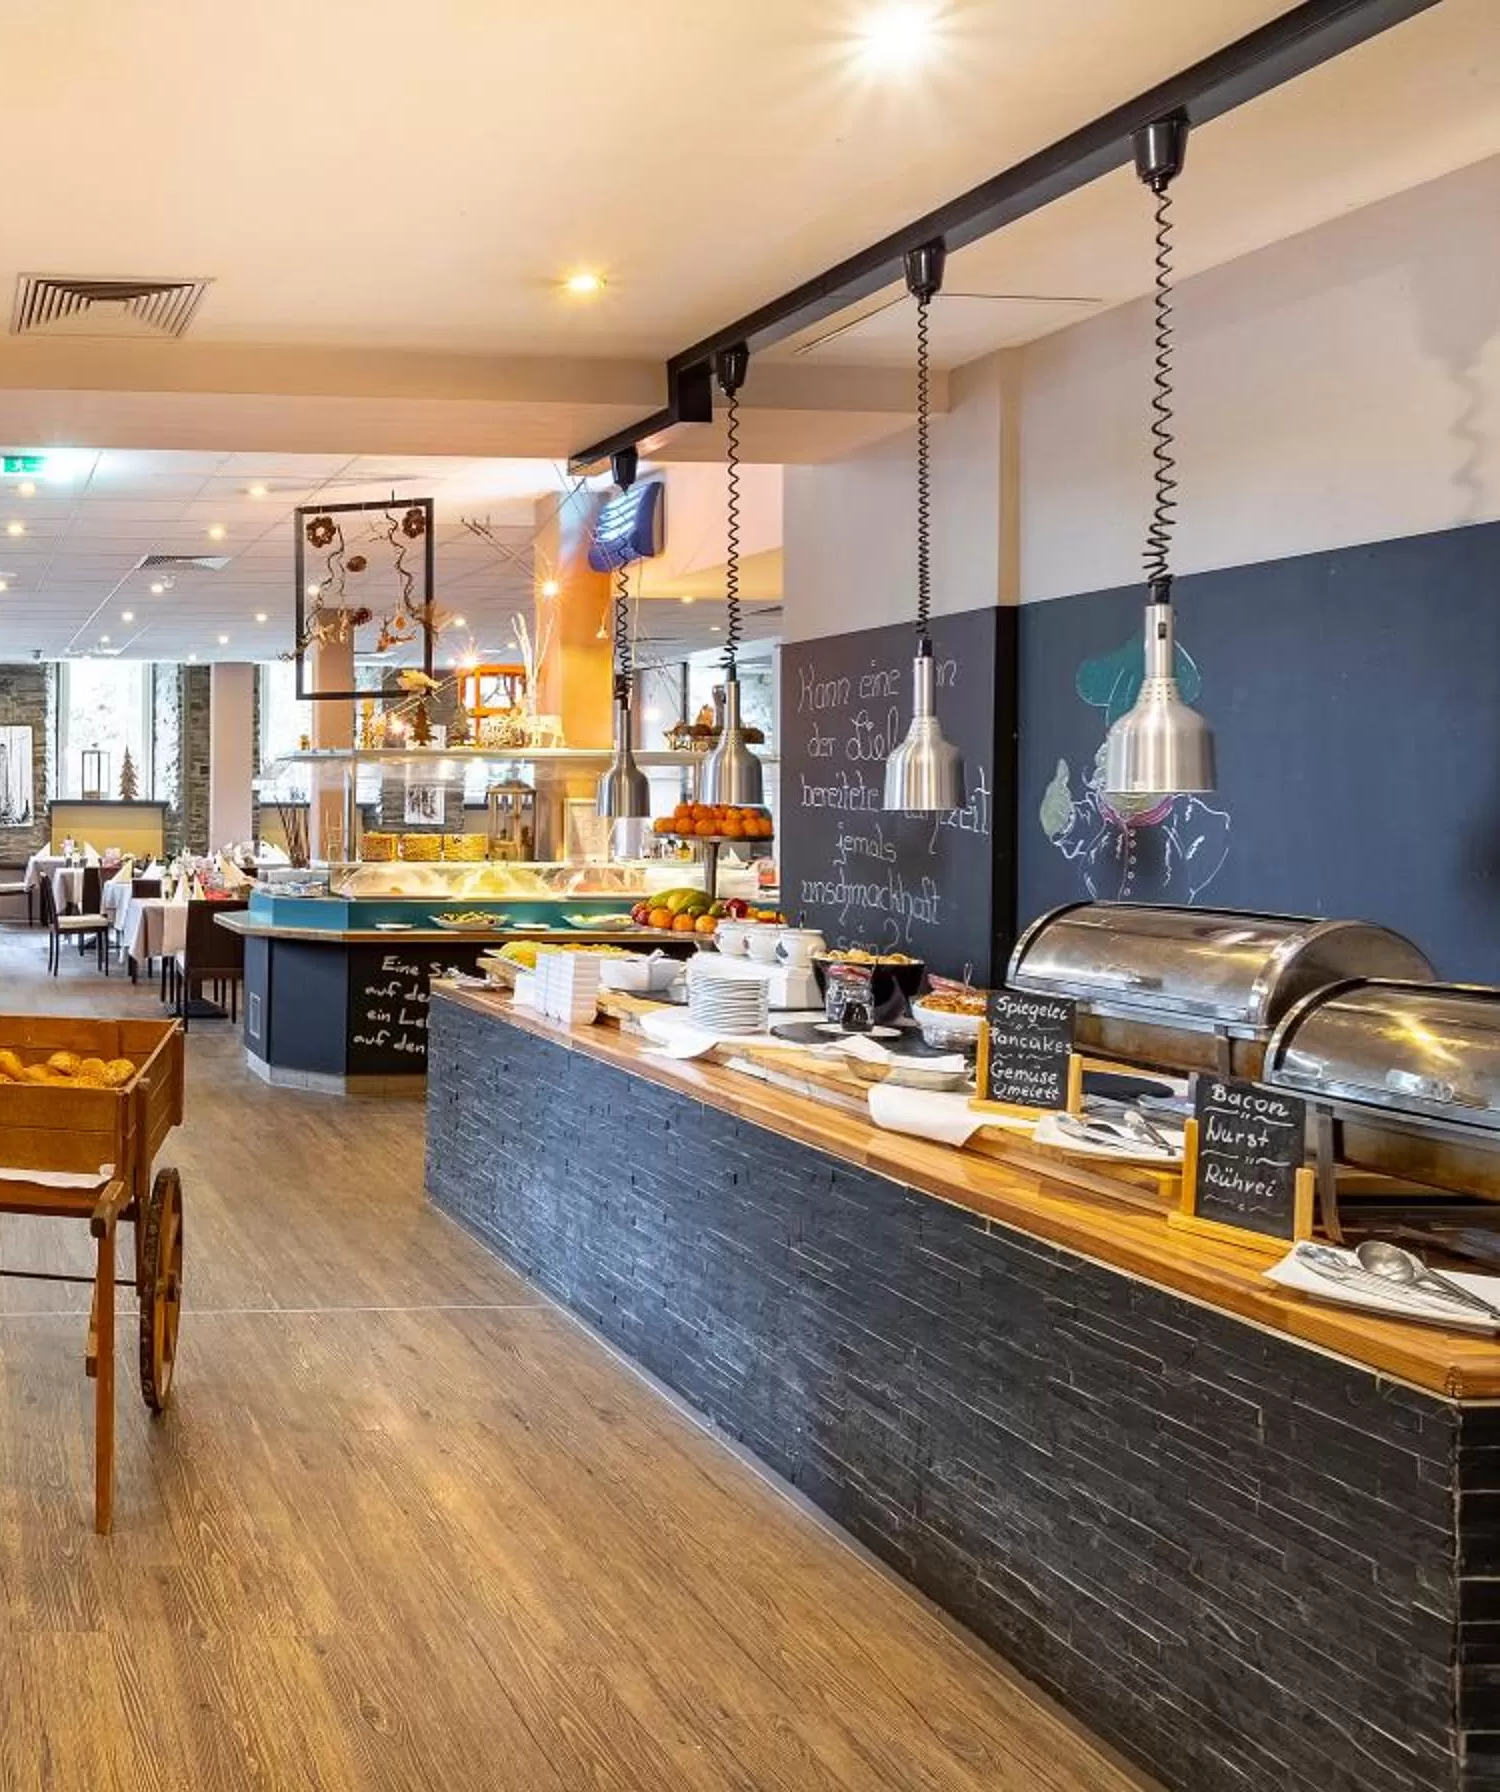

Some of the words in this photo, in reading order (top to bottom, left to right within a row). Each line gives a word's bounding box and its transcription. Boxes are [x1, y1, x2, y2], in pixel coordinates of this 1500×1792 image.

[798, 663, 850, 712] Kann
[808, 721, 836, 757] der
[833, 820, 897, 866] jemals
[801, 867, 941, 943] unschmackhaft
[381, 955, 419, 976] Eine
[365, 981, 401, 997] auf
[366, 1009, 391, 1023] ein
[996, 995, 1073, 1023] Spiegelei
[353, 1029, 391, 1046] auf
[989, 1026, 1073, 1054] Pancakes
[990, 1059, 1058, 1085] Gemüse
[993, 1082, 1060, 1101] Omelett
[1211, 1083, 1290, 1118] Bacon
[1205, 1115, 1270, 1149] Wurst
[1204, 1162, 1277, 1199] Rührei
